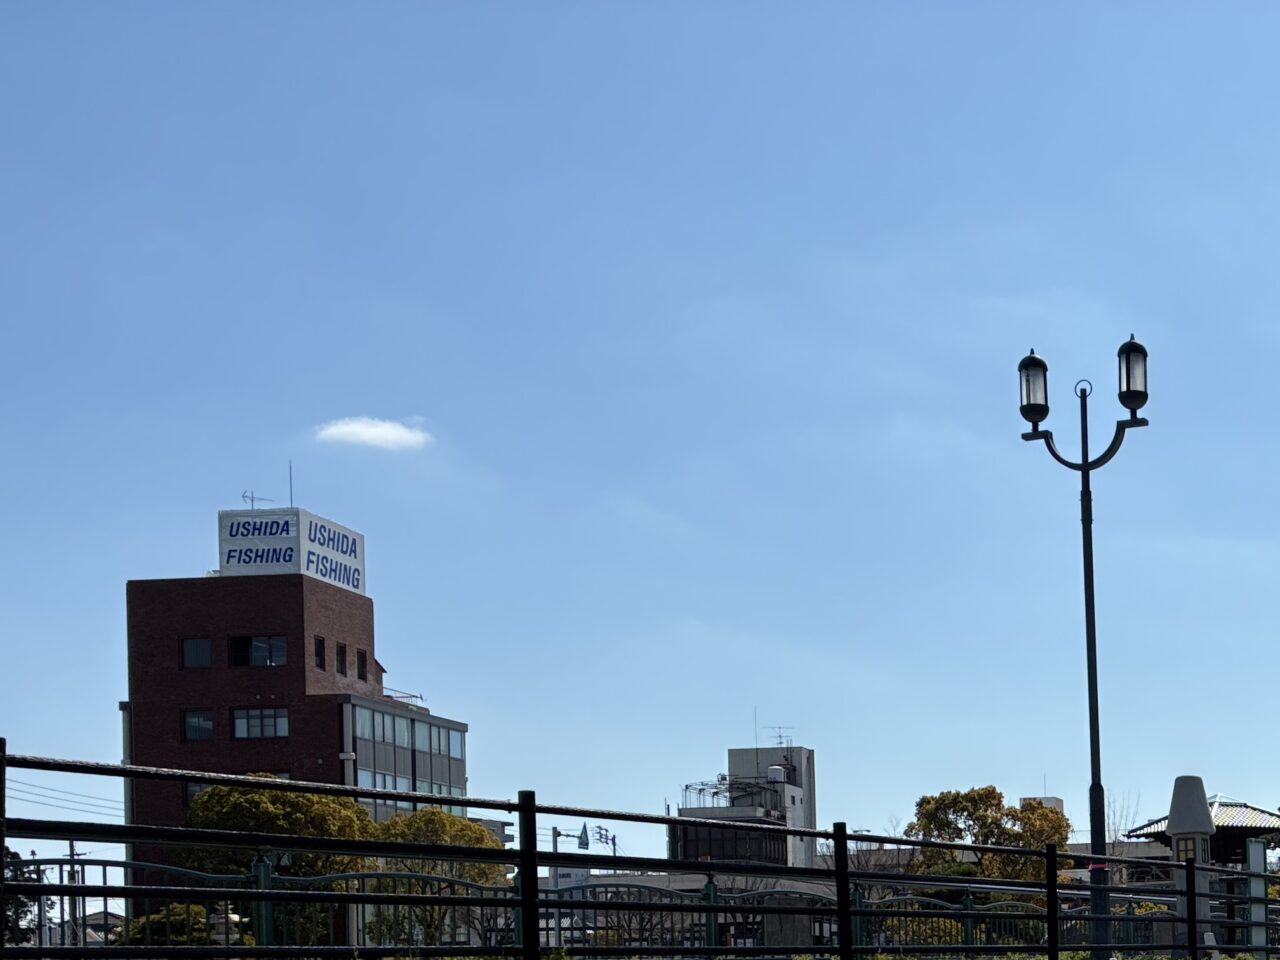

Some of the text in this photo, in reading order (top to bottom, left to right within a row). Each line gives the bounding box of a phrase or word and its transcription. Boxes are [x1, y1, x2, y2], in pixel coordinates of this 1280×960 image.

[229, 520, 290, 537] USHIDA
[308, 520, 357, 560] USHIDA
[226, 547, 294, 564] FISHING
[306, 550, 361, 589] FISHING
